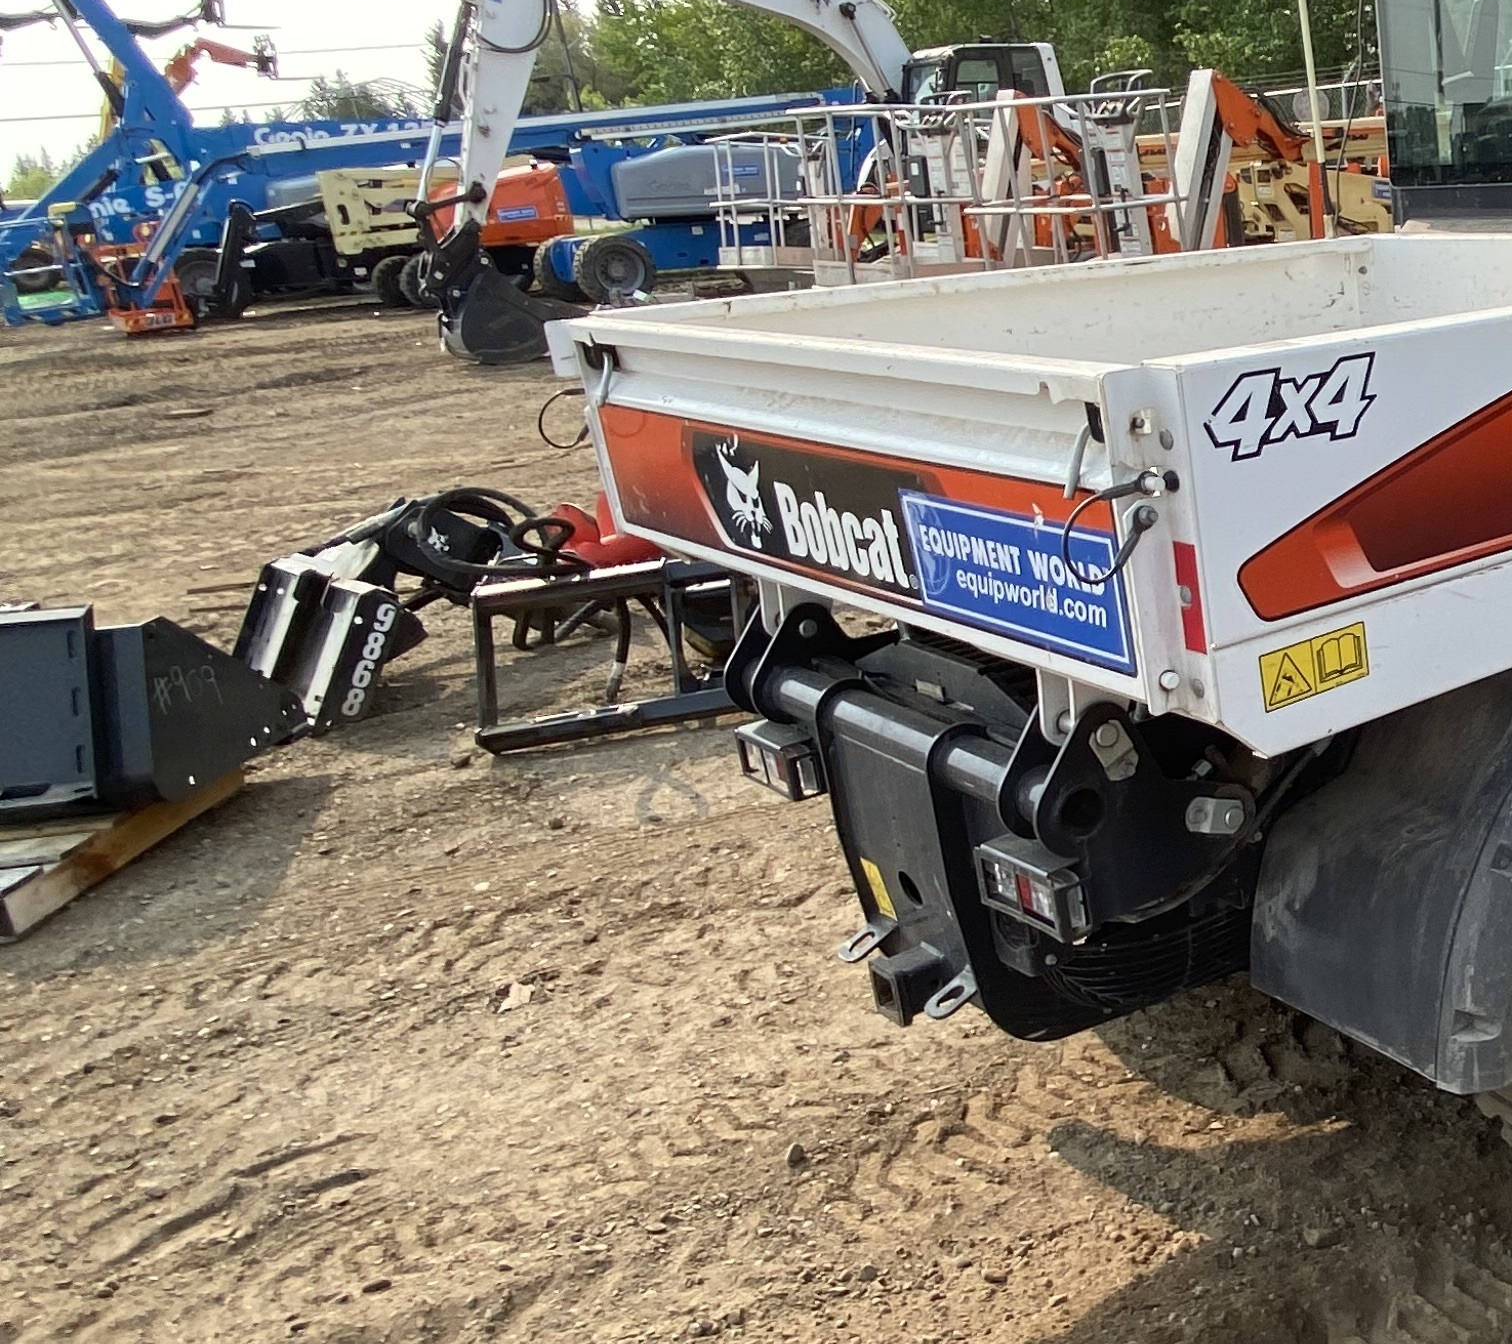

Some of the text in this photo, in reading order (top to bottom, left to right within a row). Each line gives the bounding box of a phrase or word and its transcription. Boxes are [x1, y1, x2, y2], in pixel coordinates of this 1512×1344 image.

[1203, 351, 1377, 462] 4x4
[773, 481, 910, 588] Bobcat
[919, 524, 1106, 596] EQUIPMENT WORLD
[956, 567, 1107, 628] equipworld.com
